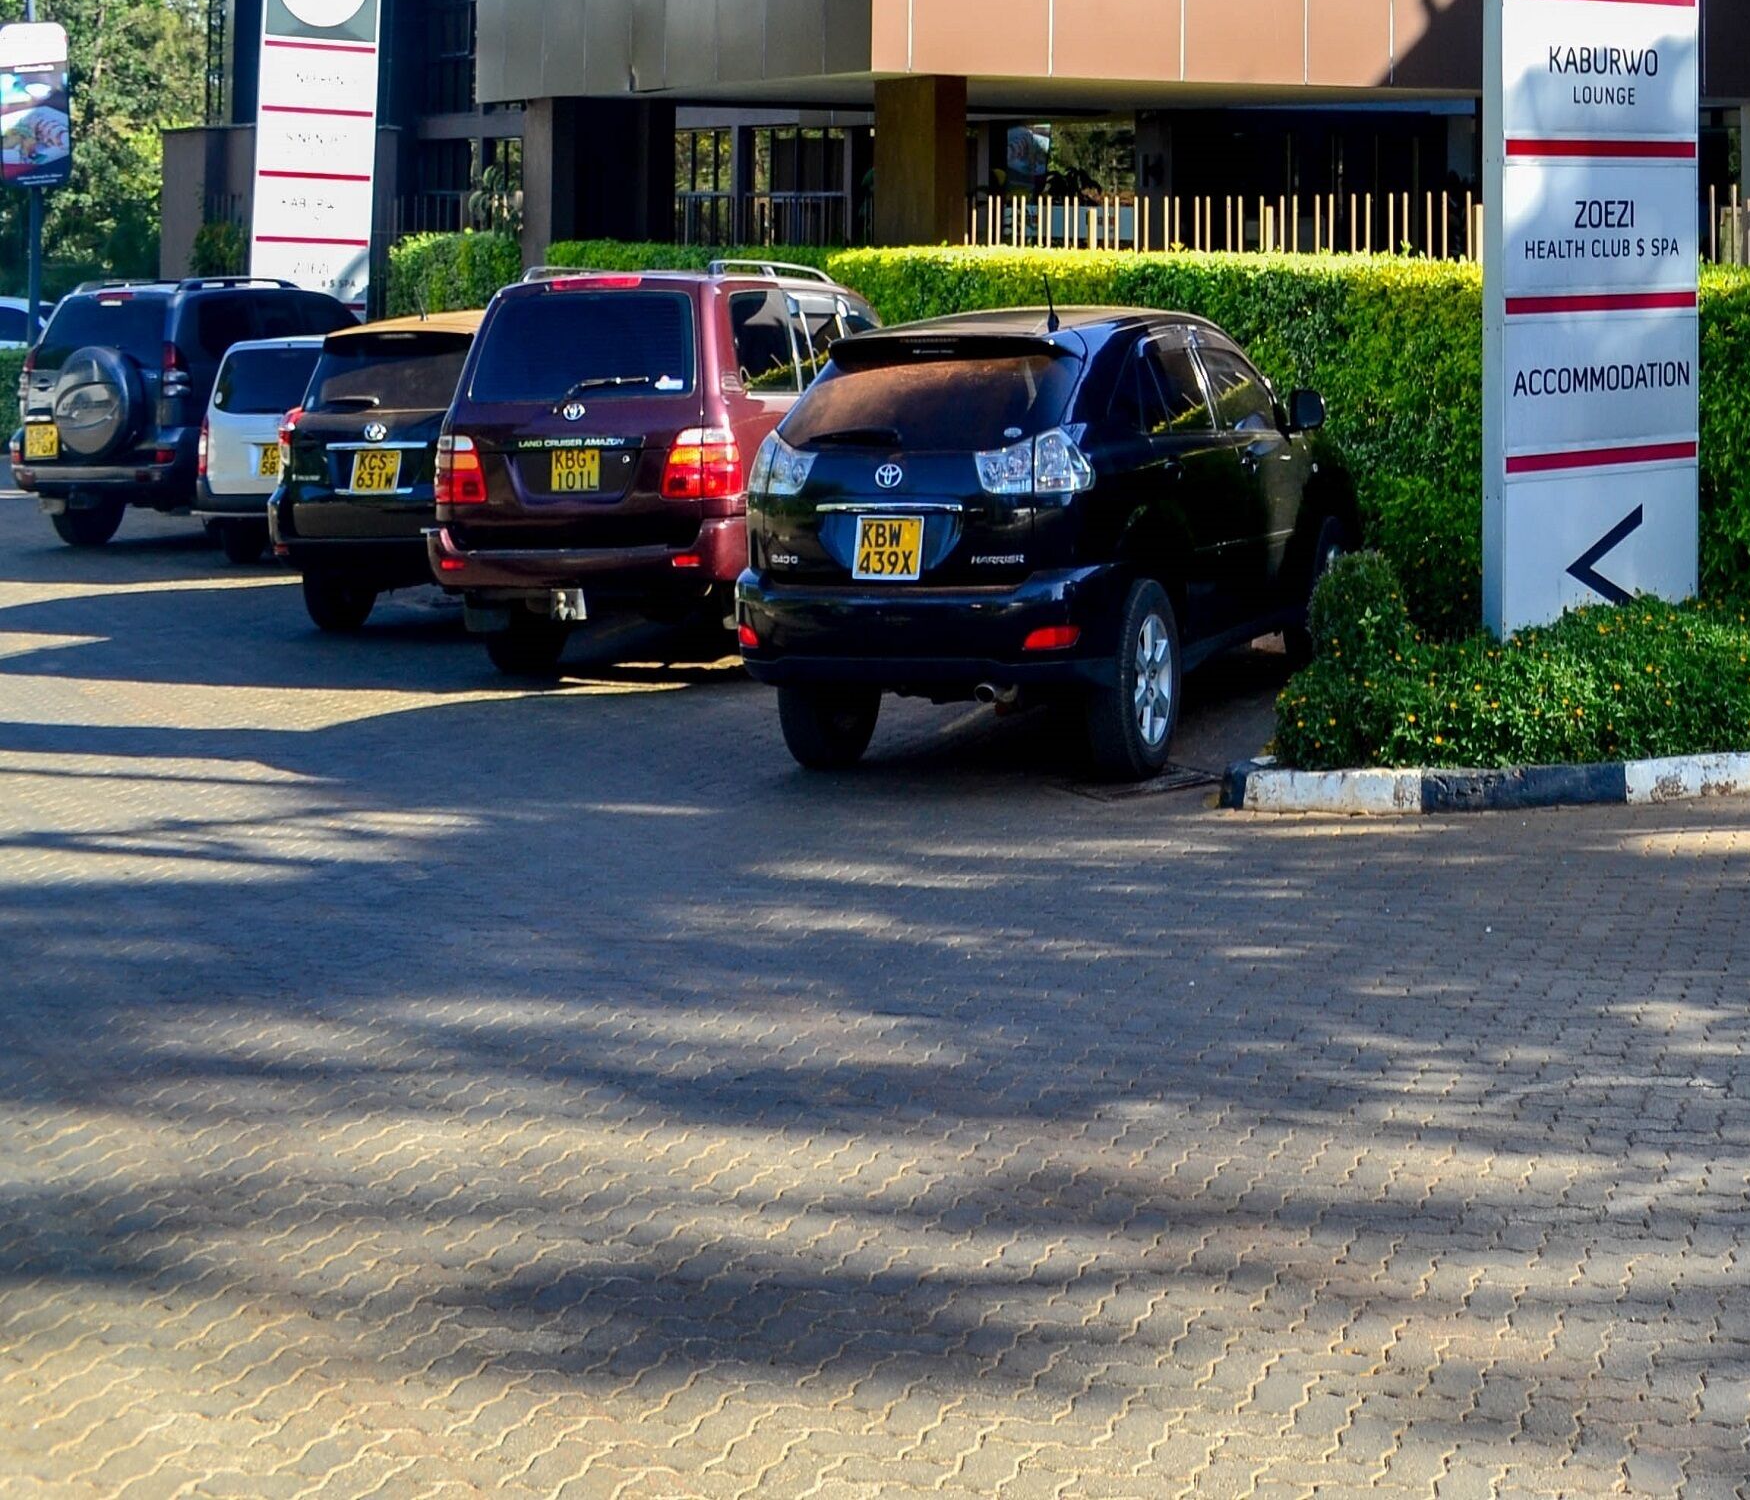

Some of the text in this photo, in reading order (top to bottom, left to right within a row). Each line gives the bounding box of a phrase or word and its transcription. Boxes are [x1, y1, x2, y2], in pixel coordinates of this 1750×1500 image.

[1549, 46, 1659, 78] KABURWO
[1573, 86, 1636, 106] LOUNGE
[1574, 200, 1635, 229] ZOEZI
[1525, 239, 1585, 260] HEALTH
[1591, 239, 1631, 258] CLUB
[1651, 237, 1680, 257] SPA
[1513, 361, 1690, 397] ACCOMMODATION
[518, 438, 625, 448] LAND CRUISER AMAZON
[262, 447, 279, 460] KC
[358, 453, 387, 471] KCS
[555, 450, 586, 470] KBG
[261, 461, 279, 474] 58
[356, 473, 395, 489] 631W
[557, 470, 598, 490] 101L
[861, 522, 902, 548] KBW
[859, 550, 913, 575] 439X
